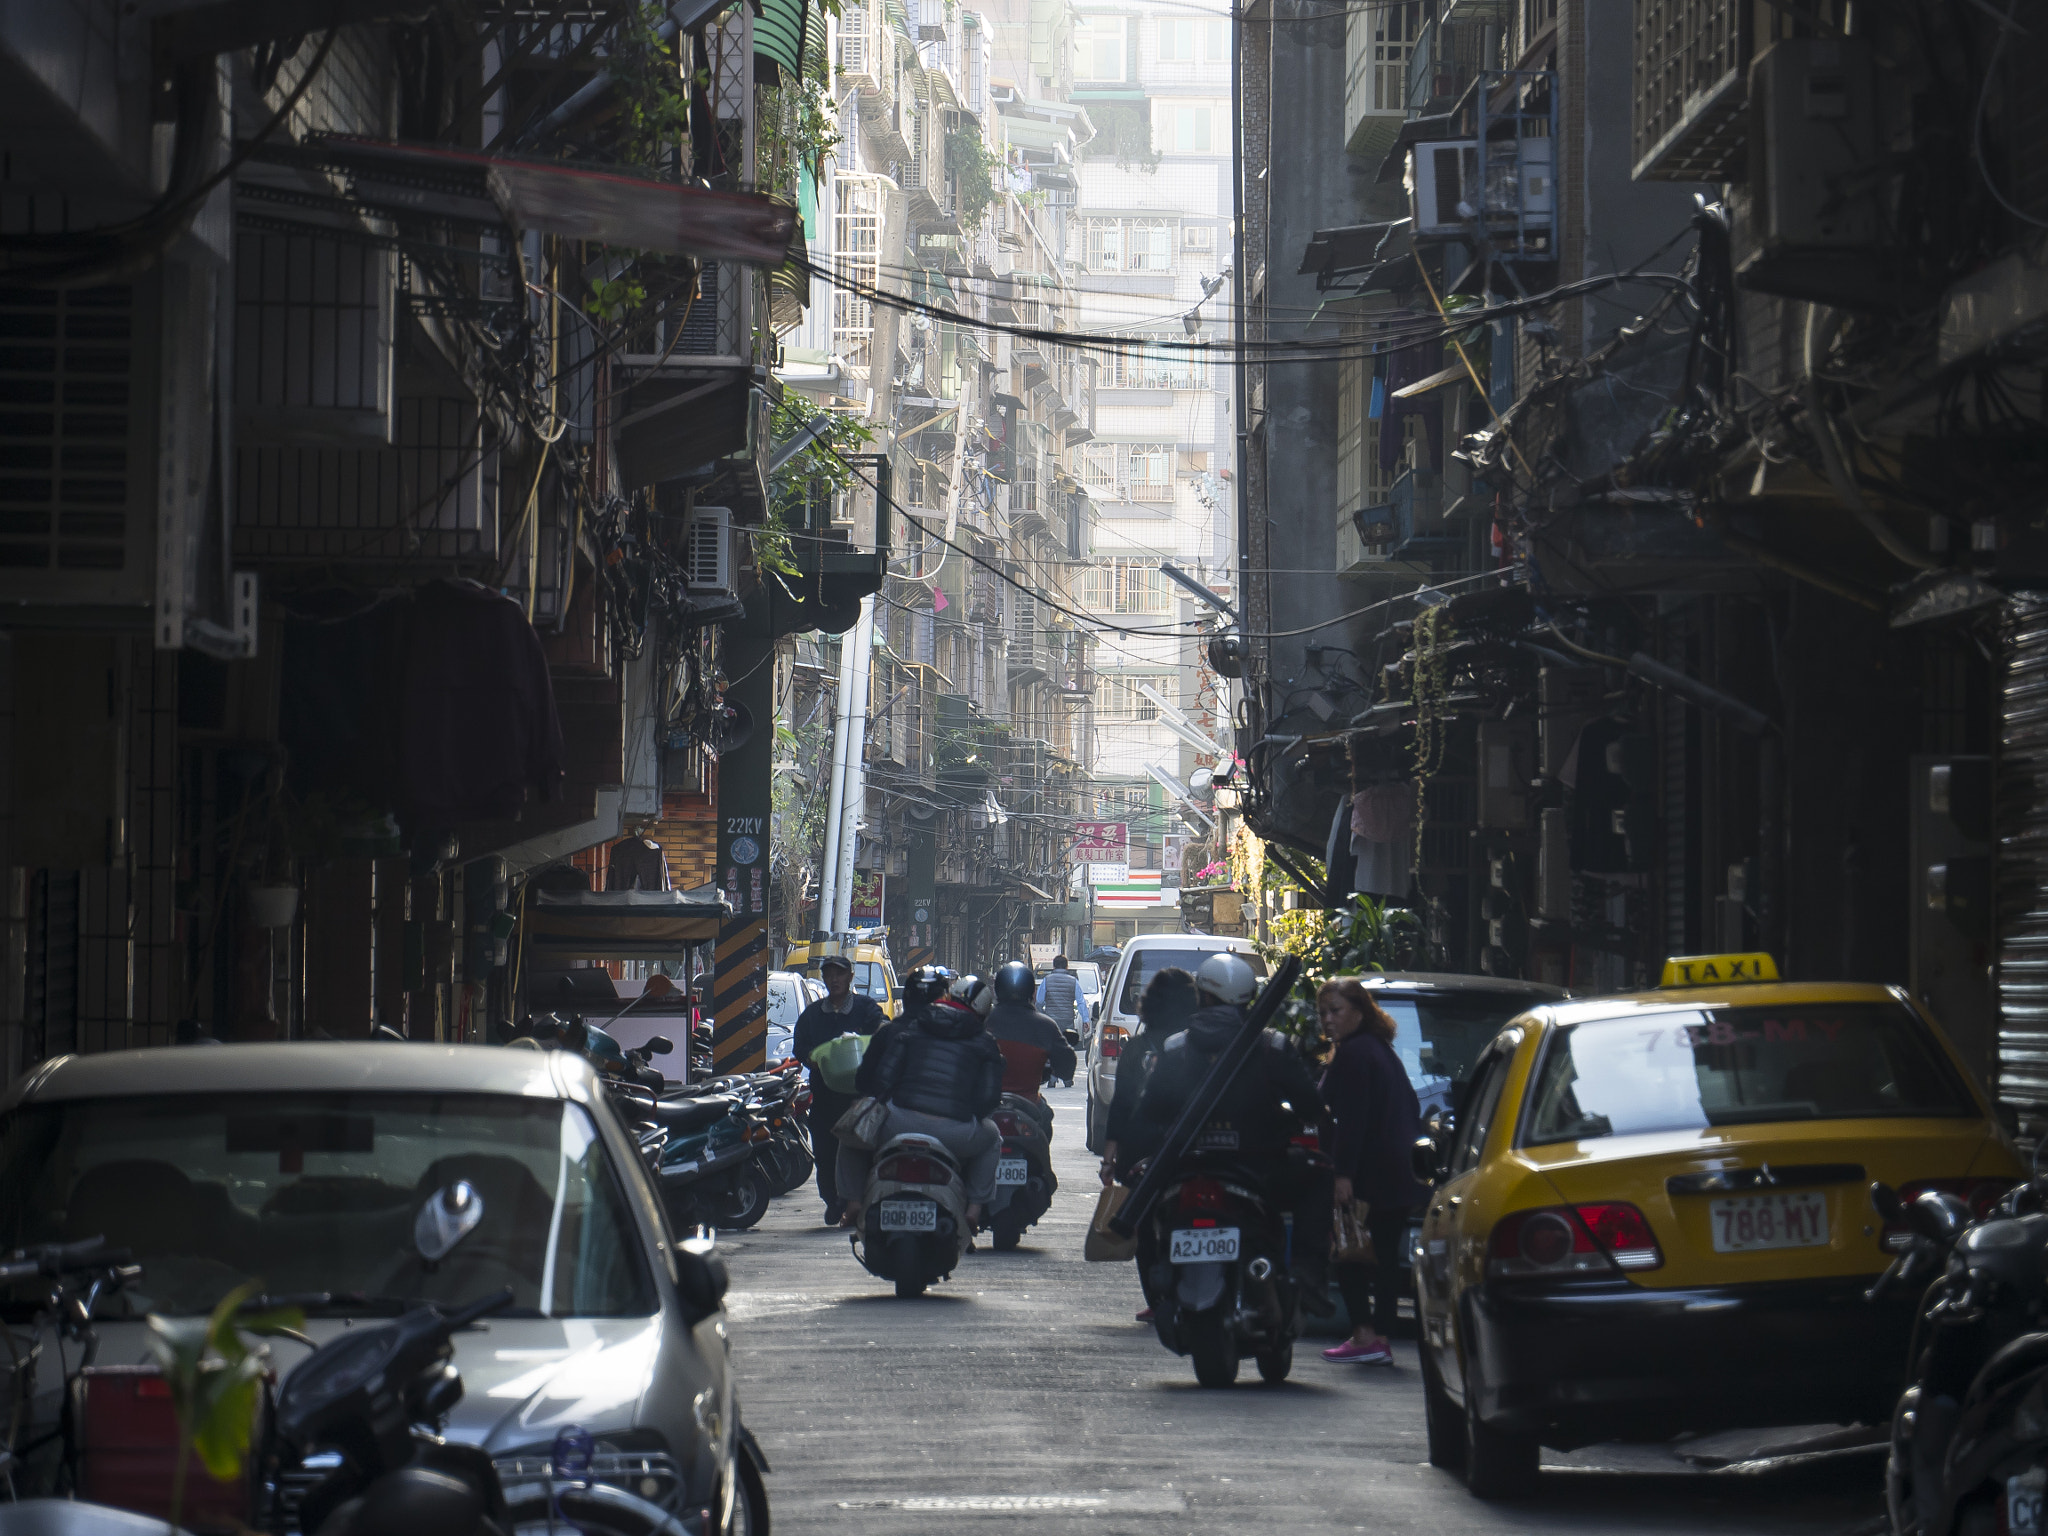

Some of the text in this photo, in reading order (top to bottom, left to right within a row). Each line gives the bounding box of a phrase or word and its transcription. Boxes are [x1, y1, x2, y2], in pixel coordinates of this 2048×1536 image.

[727, 817, 762, 834] 22KV
[1074, 848, 1125, 861] 美髮工作室
[914, 898, 931, 907] 22KV
[1679, 959, 1762, 982] TAXI
[1638, 1018, 1845, 1052] 788-MY
[995, 1167, 1026, 1181] J-806
[1715, 1202, 1821, 1245] 788-MY
[1172, 1238, 1237, 1257] A2J-080
